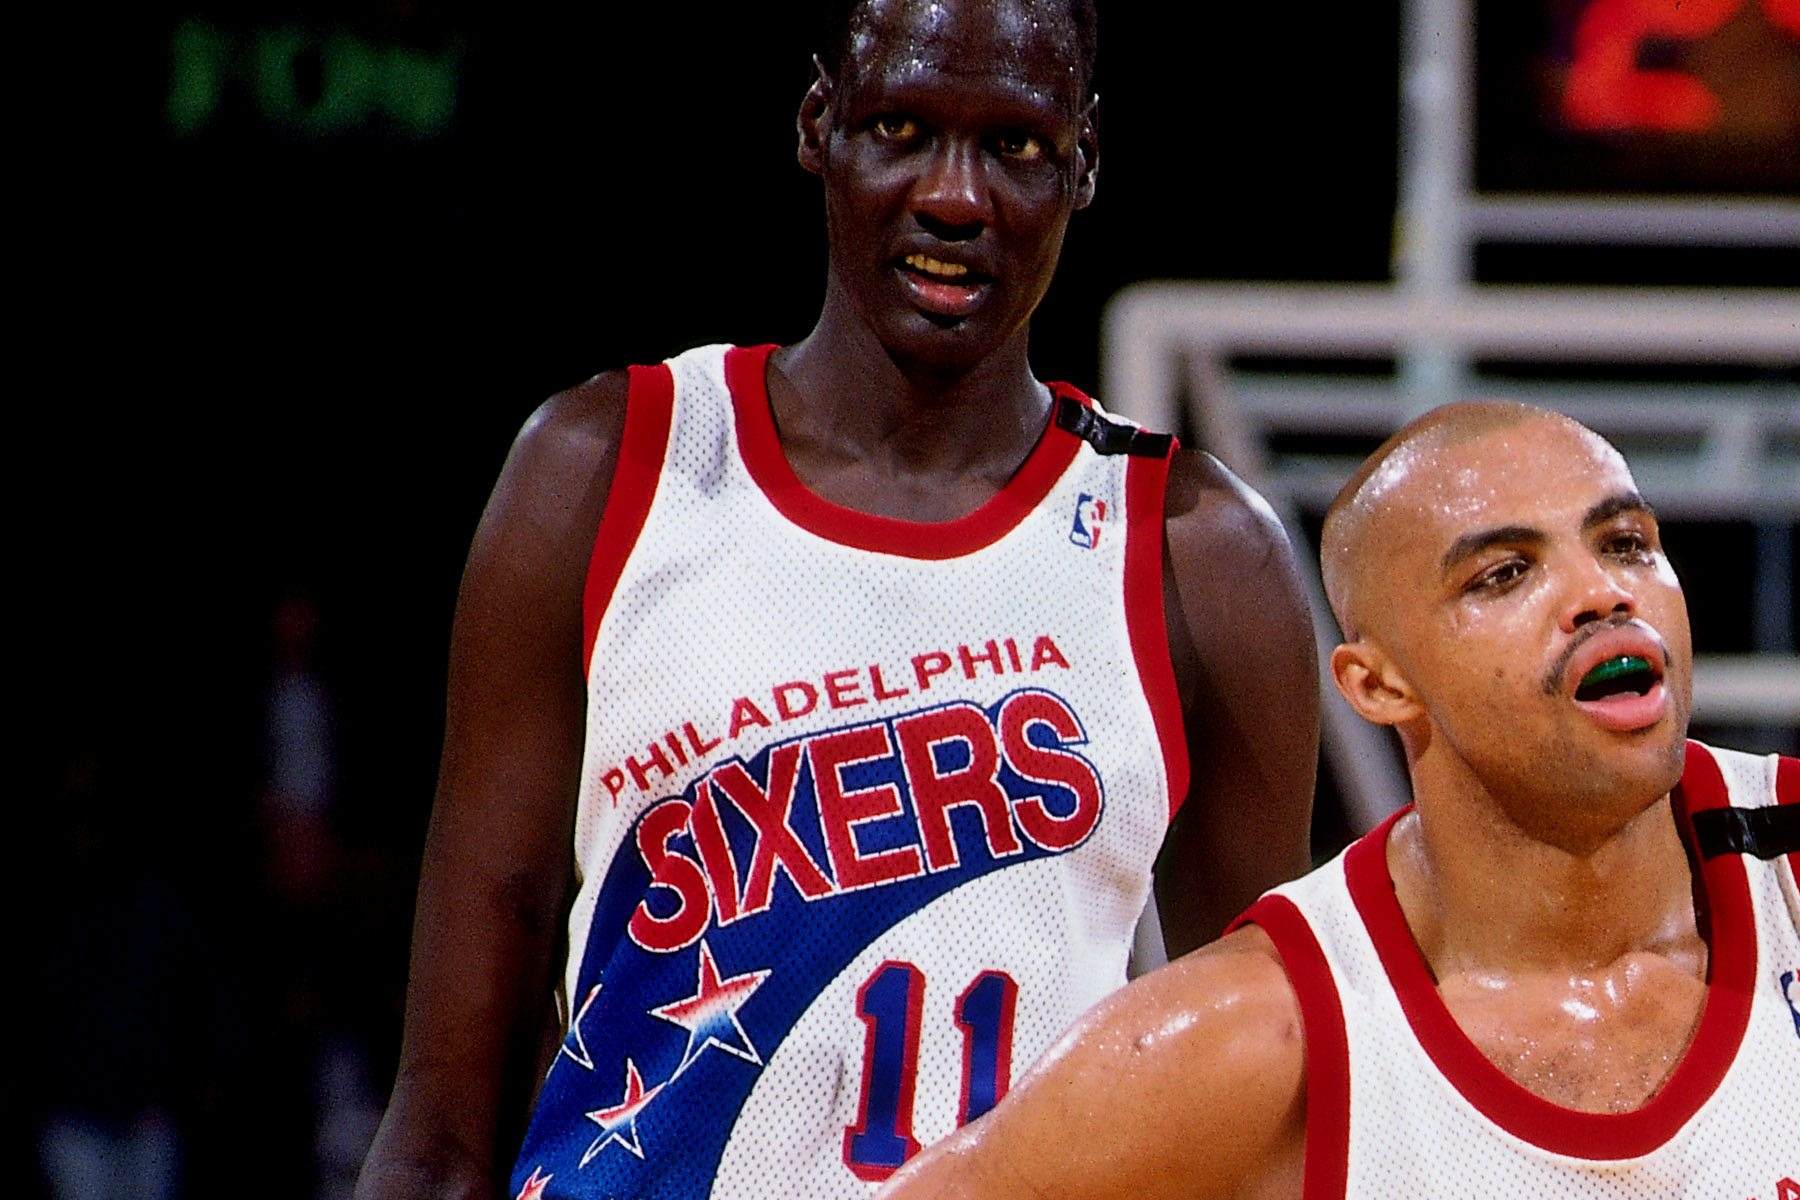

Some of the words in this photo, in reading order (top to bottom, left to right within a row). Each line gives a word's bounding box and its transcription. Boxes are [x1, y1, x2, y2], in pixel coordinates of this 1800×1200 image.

[600, 634, 1071, 806] PHILADELPHIA
[627, 686, 1105, 953] SIXERS
[842, 959, 1019, 1182] 11
